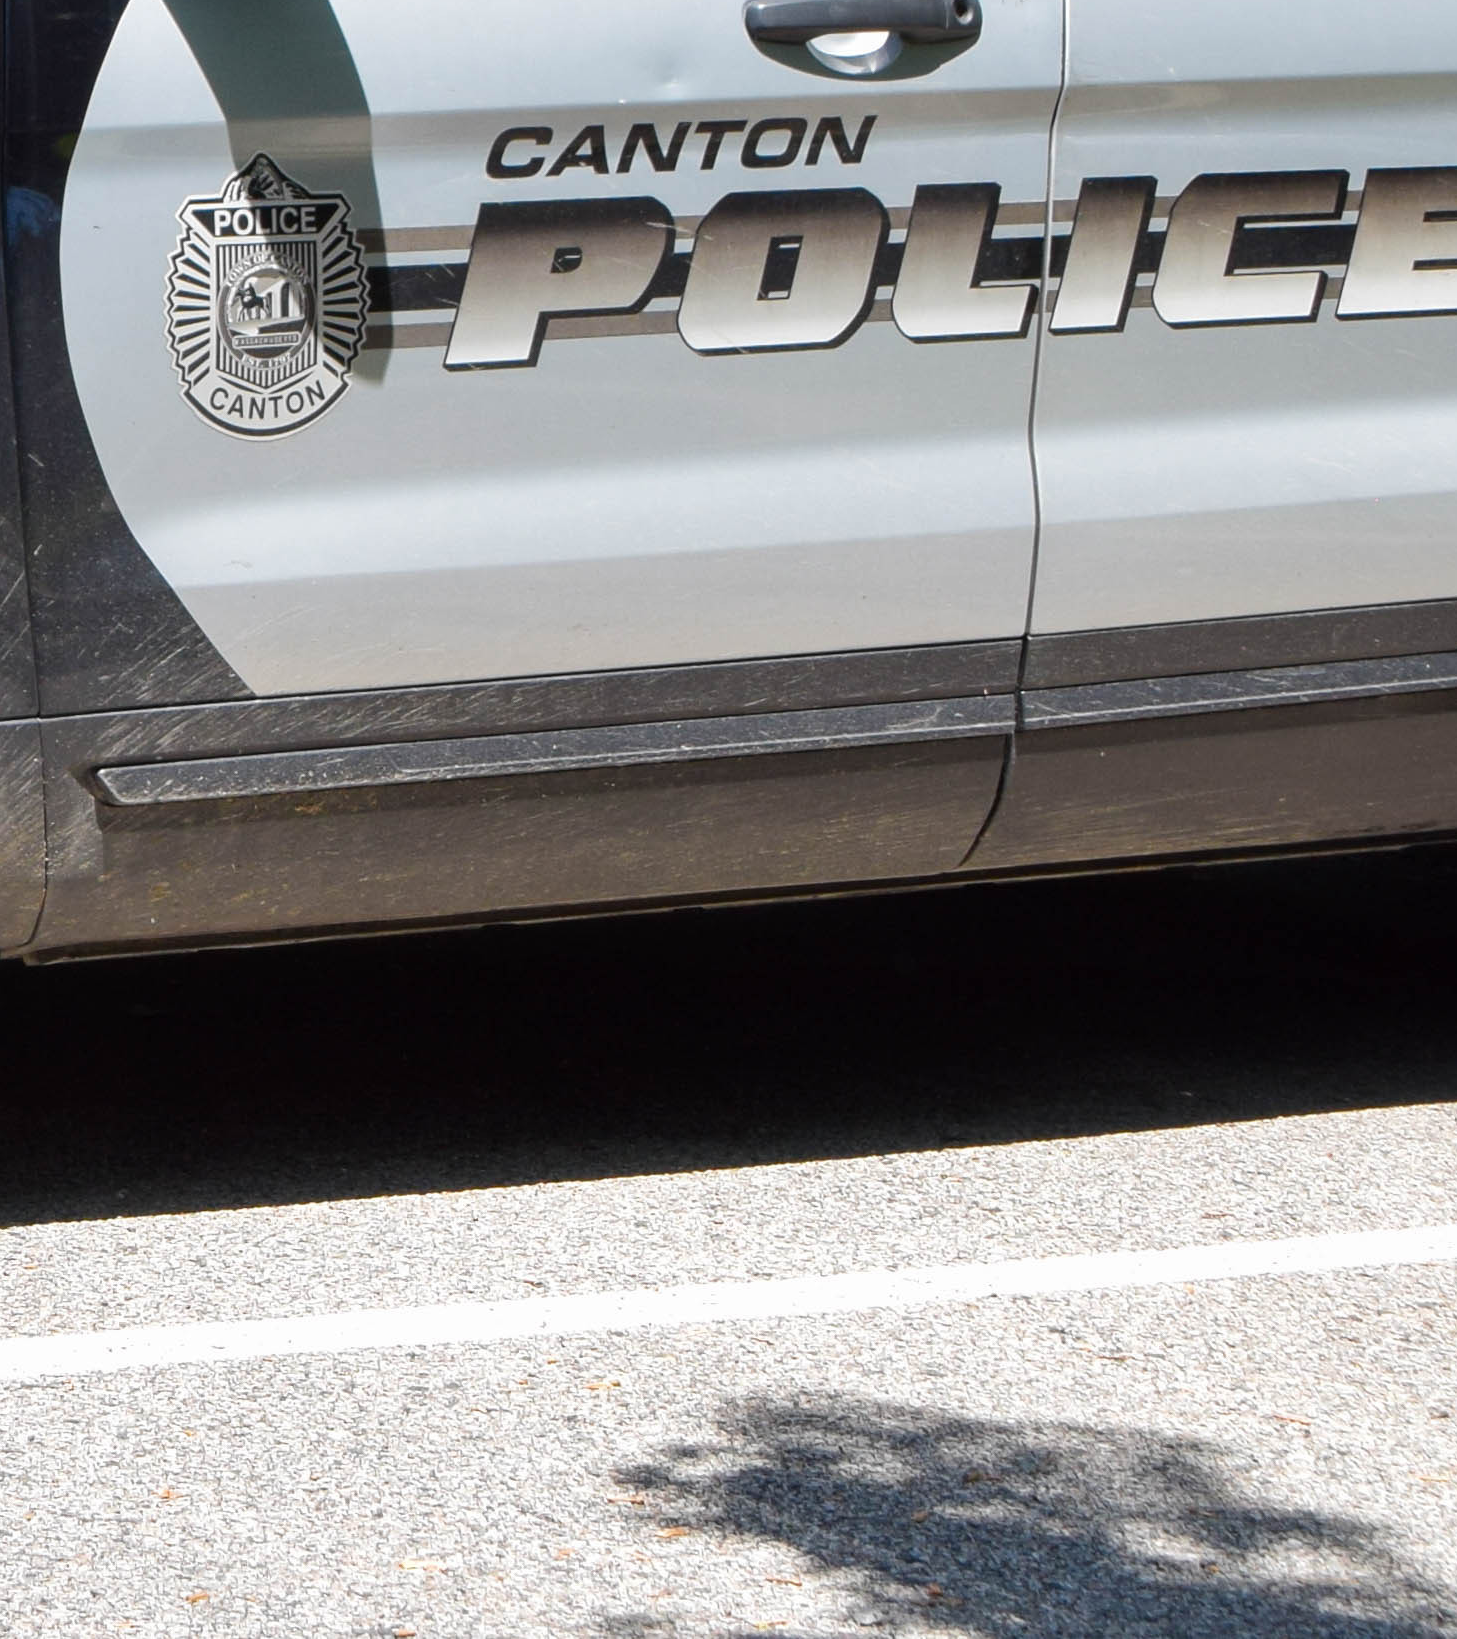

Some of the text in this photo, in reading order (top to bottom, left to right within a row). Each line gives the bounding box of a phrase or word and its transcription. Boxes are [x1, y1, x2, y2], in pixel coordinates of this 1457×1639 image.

[483, 114, 879, 181] CANTON
[213, 206, 318, 237] POLICE
[208, 380, 326, 420] CANTON
